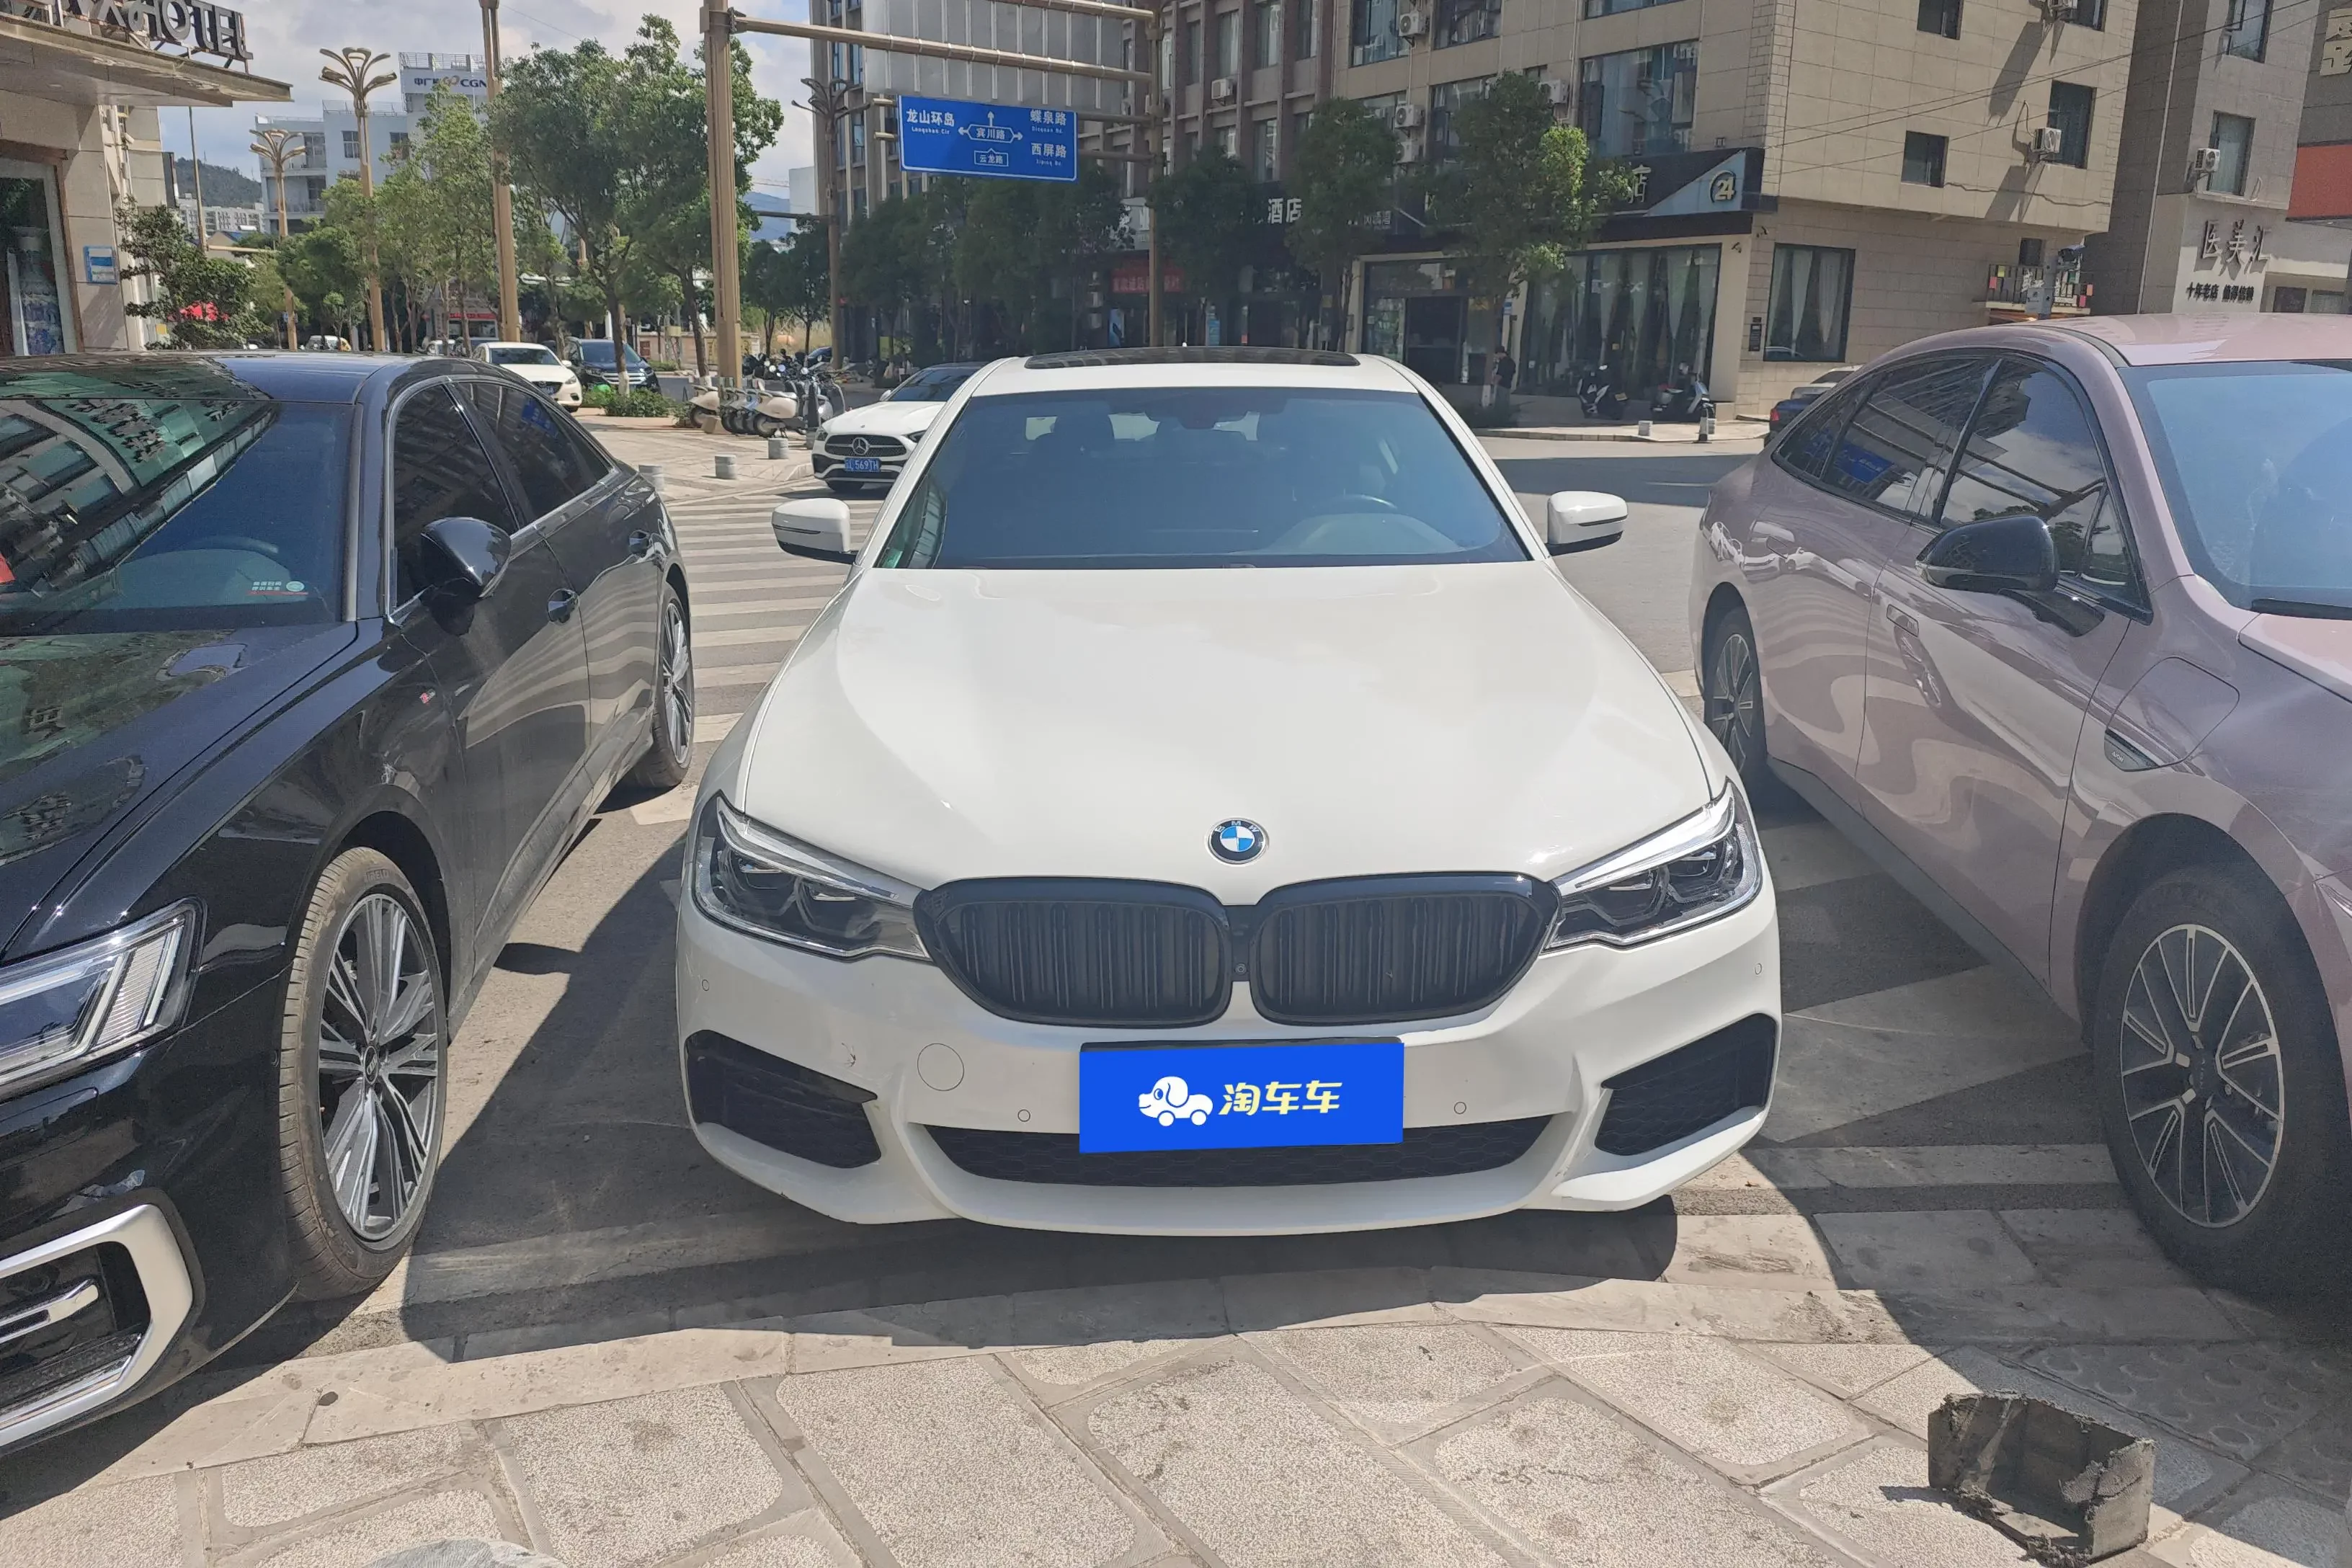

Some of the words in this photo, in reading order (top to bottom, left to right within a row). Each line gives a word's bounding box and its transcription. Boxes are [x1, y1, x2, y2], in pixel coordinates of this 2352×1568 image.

[127, 0, 254, 61] HOTEL
[906, 108, 955, 127] 龙山环岛
[1030, 109, 1066, 126] 蝶泉路
[976, 128, 1005, 140] 宾川路
[979, 153, 1003, 164] 云龙路
[1030, 142, 1066, 158] 西屏路
[1714, 176, 1735, 201] 24
[1268, 197, 1302, 224] 酒店
[2201, 219, 2270, 264] 医美汇
[2186, 282, 2219, 300] 十年老店
[1214, 820, 1260, 833] BMW
